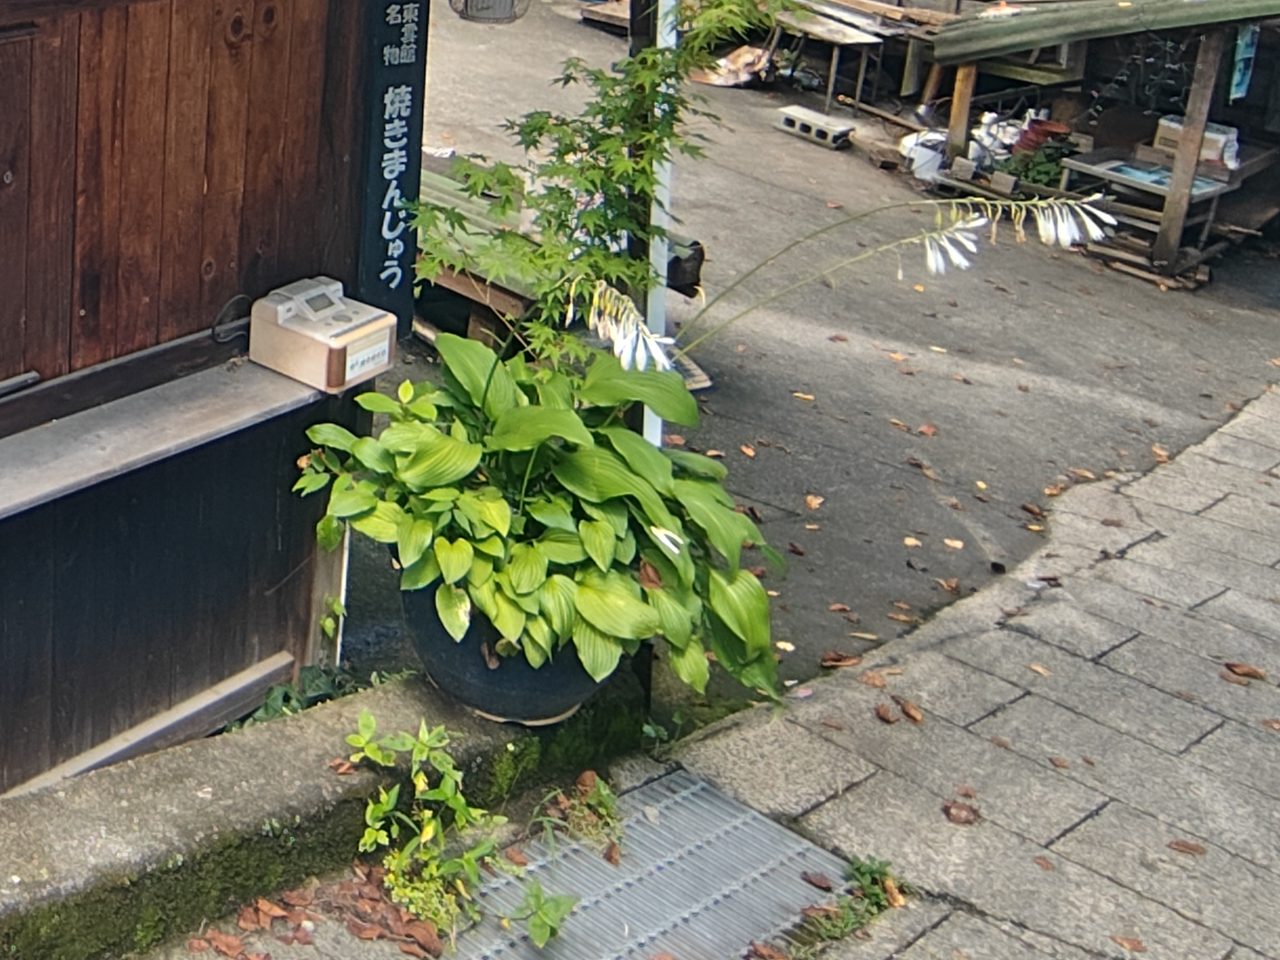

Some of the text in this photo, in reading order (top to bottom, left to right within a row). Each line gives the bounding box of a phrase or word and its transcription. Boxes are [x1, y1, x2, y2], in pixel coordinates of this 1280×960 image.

[400, 3, 420, 64] 東雲館
[379, 85, 412, 289] 焼きまんじゅう
